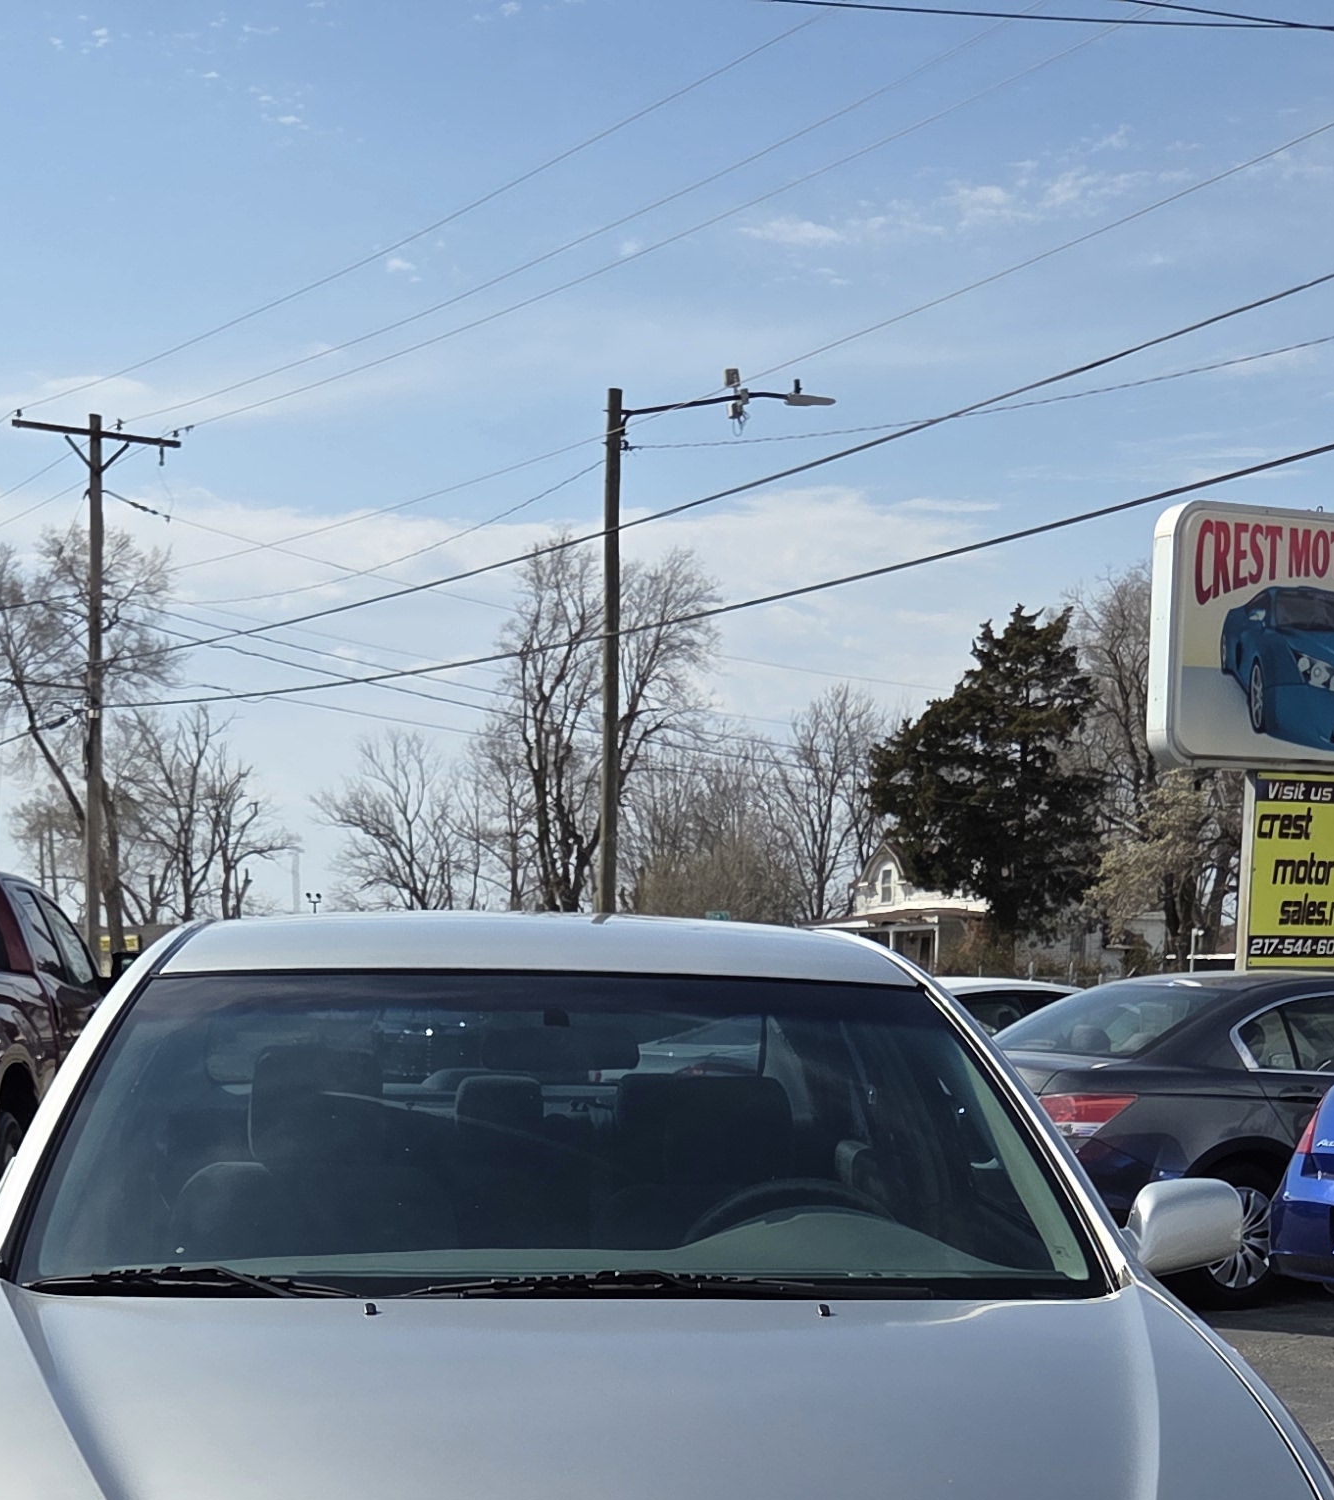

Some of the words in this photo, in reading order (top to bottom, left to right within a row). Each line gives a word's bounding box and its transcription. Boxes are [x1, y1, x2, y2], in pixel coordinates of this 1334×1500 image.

[1195, 519, 1283, 605] CREST
[1268, 782, 1306, 800] Visit
[1310, 786, 1333, 800] us
[1257, 807, 1313, 840] crest
